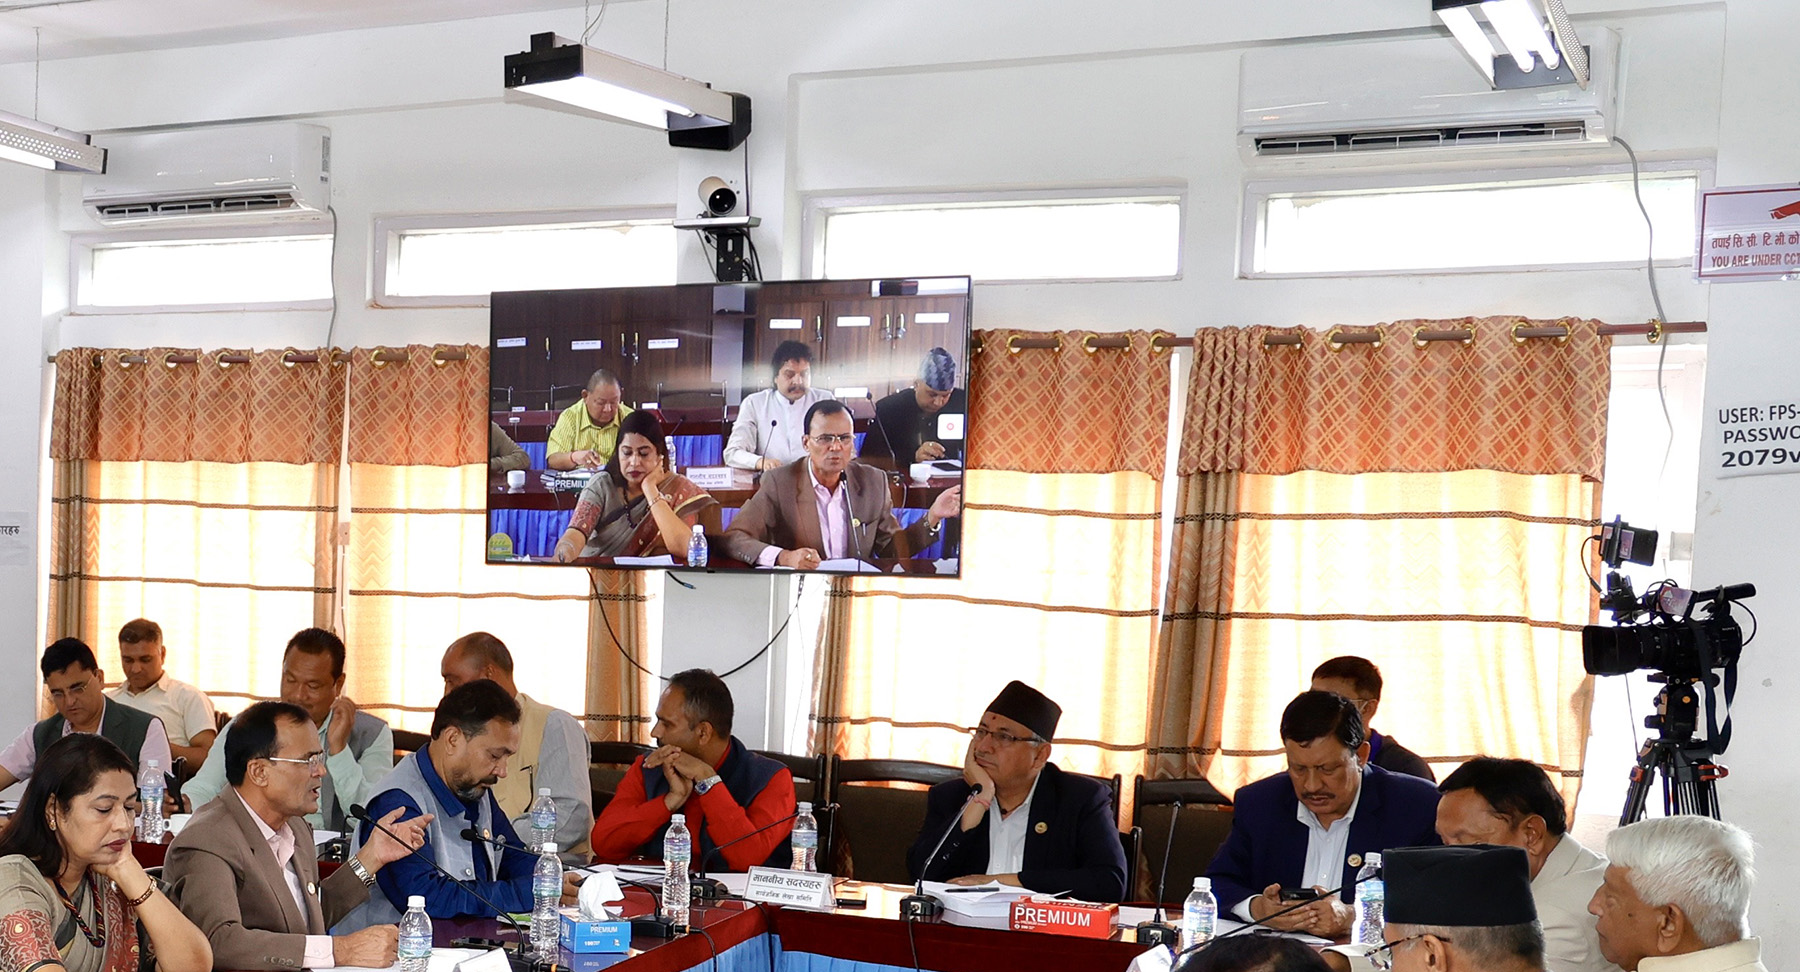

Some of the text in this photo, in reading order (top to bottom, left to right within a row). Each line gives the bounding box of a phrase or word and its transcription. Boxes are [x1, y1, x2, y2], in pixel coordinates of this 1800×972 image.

[1711, 256, 1729, 267] YOU
[1731, 255, 1749, 267] ARE
[1752, 254, 1782, 266] UNDER
[1719, 404, 1800, 424] USER: FPS-
[1724, 425, 1800, 444] PASSWO
[555, 479, 587, 488] PREMIU
[753, 874, 823, 890] माननीय सदस्यहरु
[1014, 906, 1091, 927] PREMIUM
